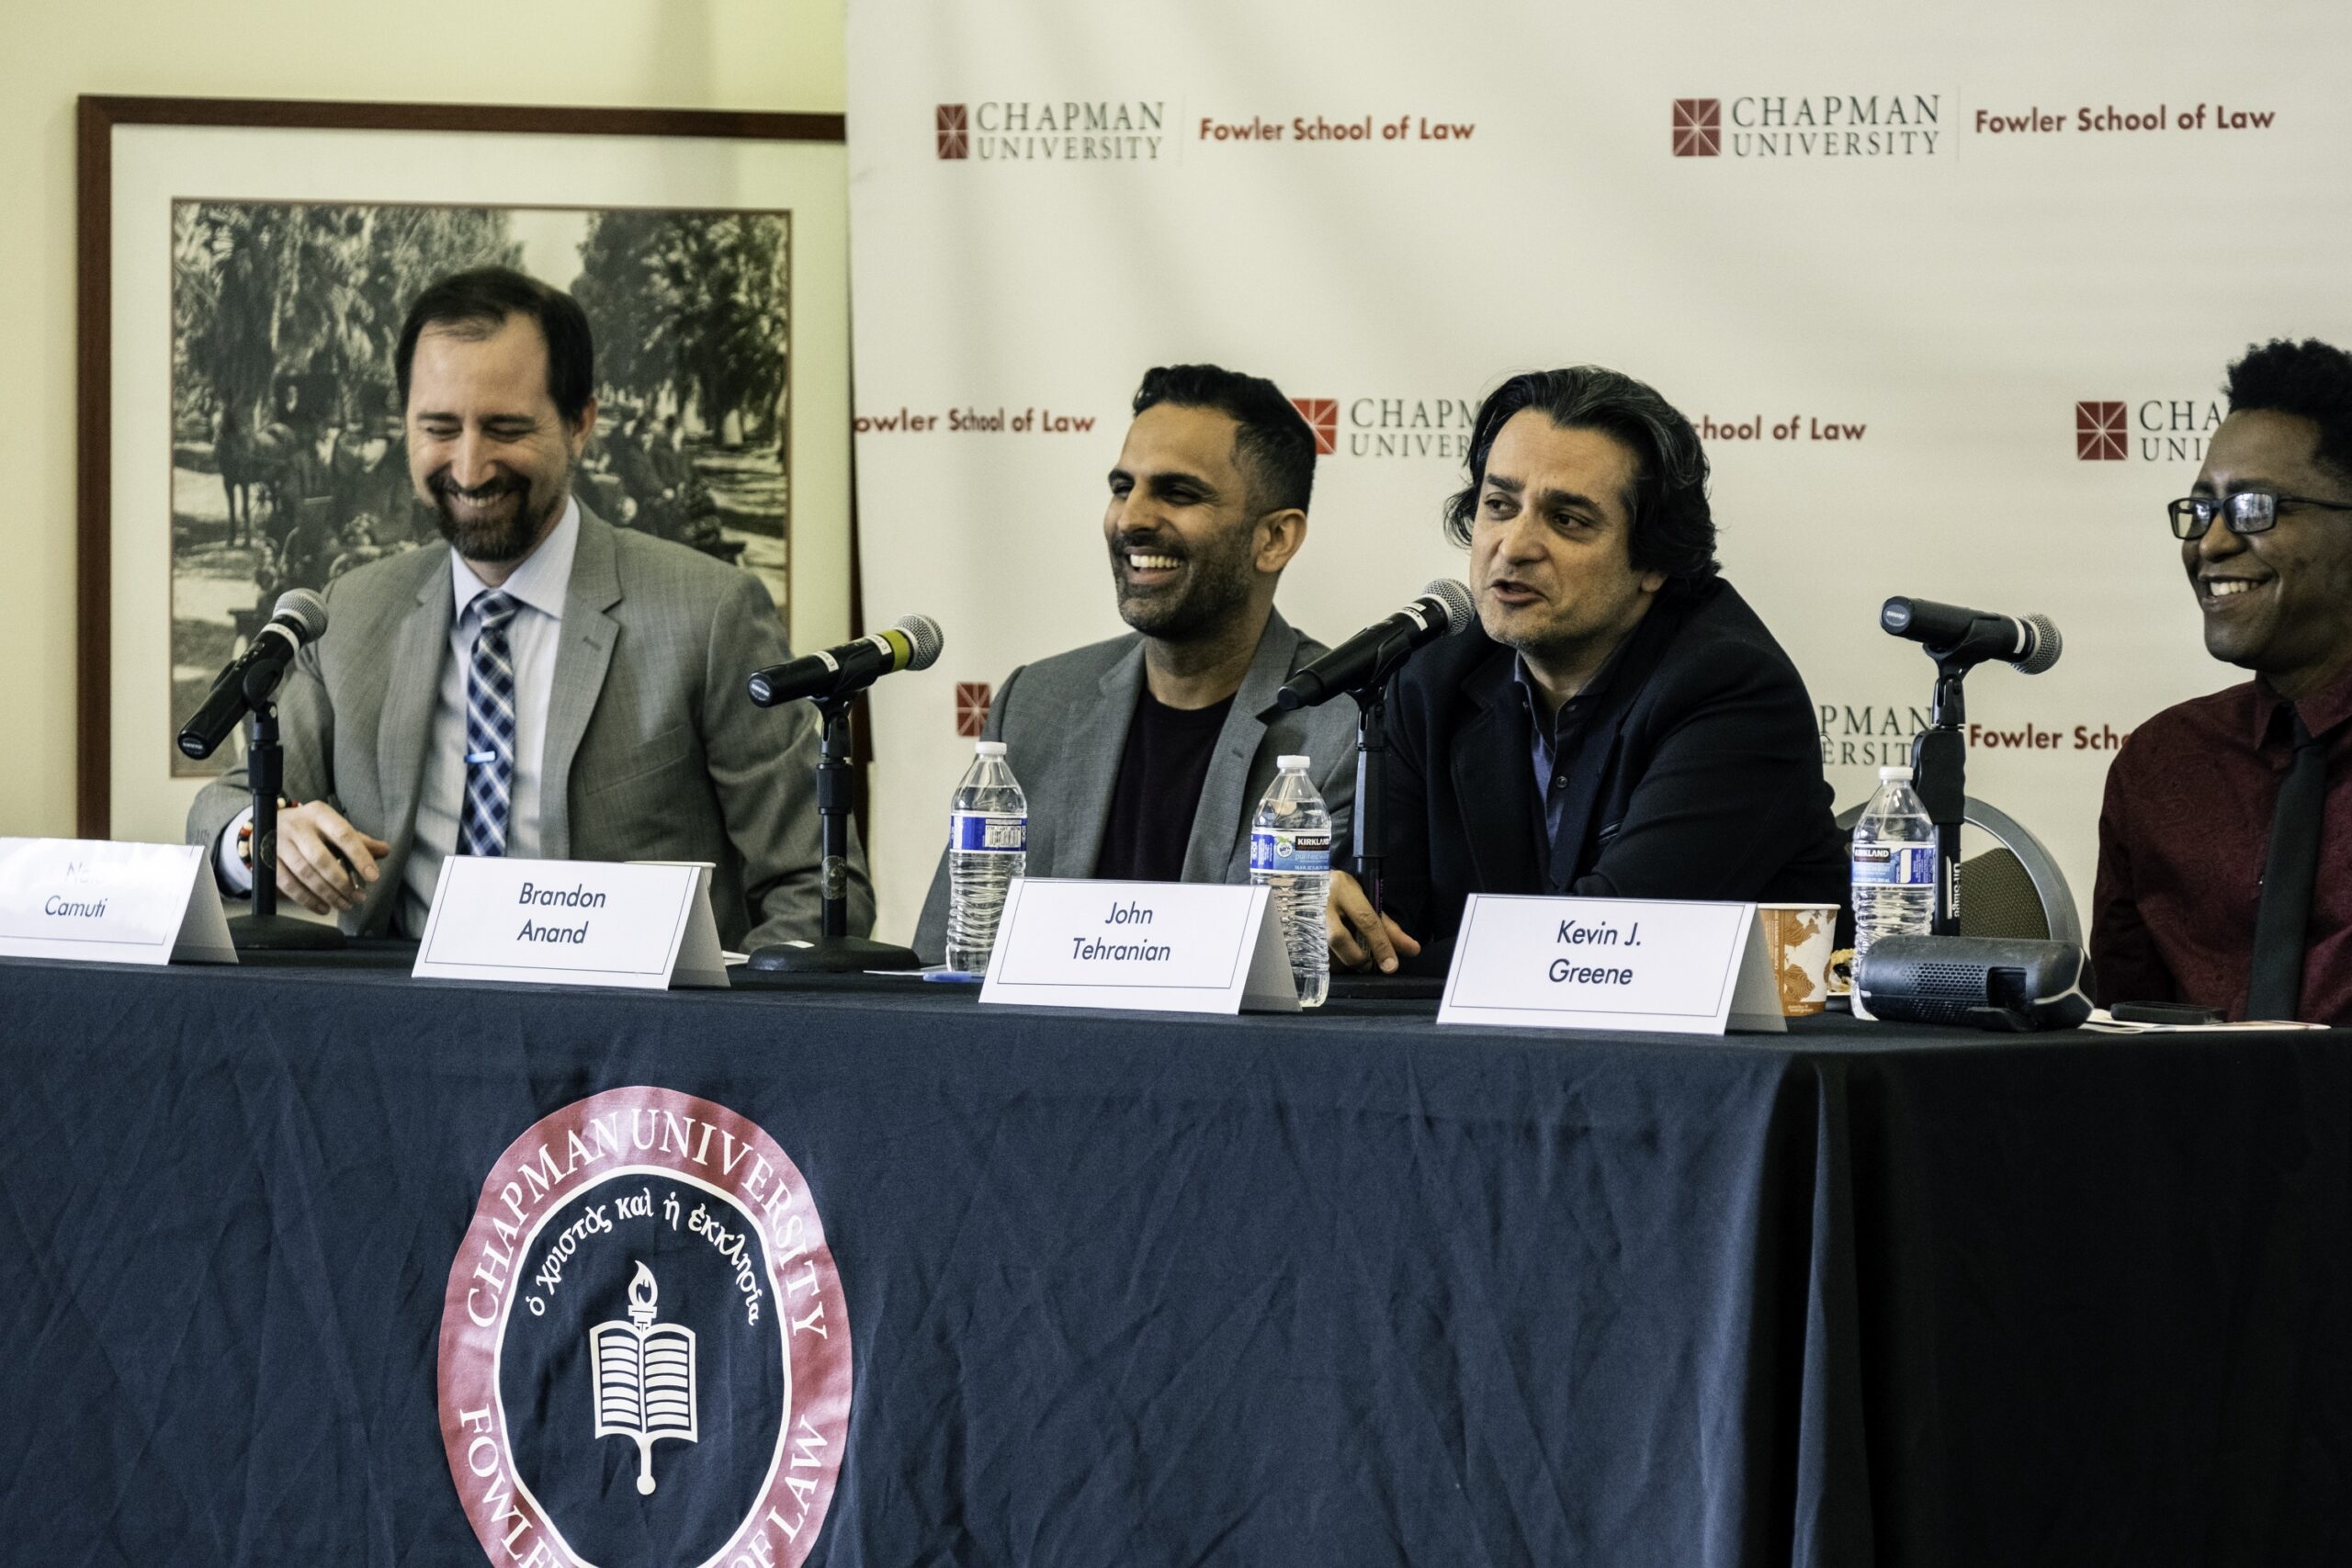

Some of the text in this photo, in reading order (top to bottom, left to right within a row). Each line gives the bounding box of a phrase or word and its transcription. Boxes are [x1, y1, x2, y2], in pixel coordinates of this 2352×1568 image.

[976, 101, 1164, 131] CHAPMAN
[1732, 94, 1940, 128] CHAPMAN
[1975, 103, 2276, 134] Fowler School of Law
[1200, 115, 1475, 141] Fowler School of Law
[977, 135, 1162, 161] UNIVERSITY
[1733, 130, 1939, 158] UNIVERSITY
[854, 407, 1095, 434] owler School of Law
[1350, 398, 1482, 429] CHAPM
[1692, 414, 1867, 441] hool of Law
[2139, 400, 2222, 432] CHA
[1351, 433, 1470, 457] UNIVER
[2141, 437, 2211, 461] UNI
[1818, 705, 1932, 737] PMAN
[1969, 722, 2064, 750] Fowler
[1822, 740, 1912, 766] ERSIT
[44, 894, 108, 918] Camuti
[518, 882, 606, 909] Brandon
[1104, 900, 1153, 925] John
[516, 919, 589, 945] Anand
[1556, 919, 1643, 947] Kevin J.
[1072, 937, 1171, 962] Tehranian
[1548, 958, 1634, 986] Greene
[467, 1108, 828, 1340] CHAPMAN UNIVERSITY
[458, 1403, 562, 1568] FOWLE
[765, 1414, 829, 1544] LAW
